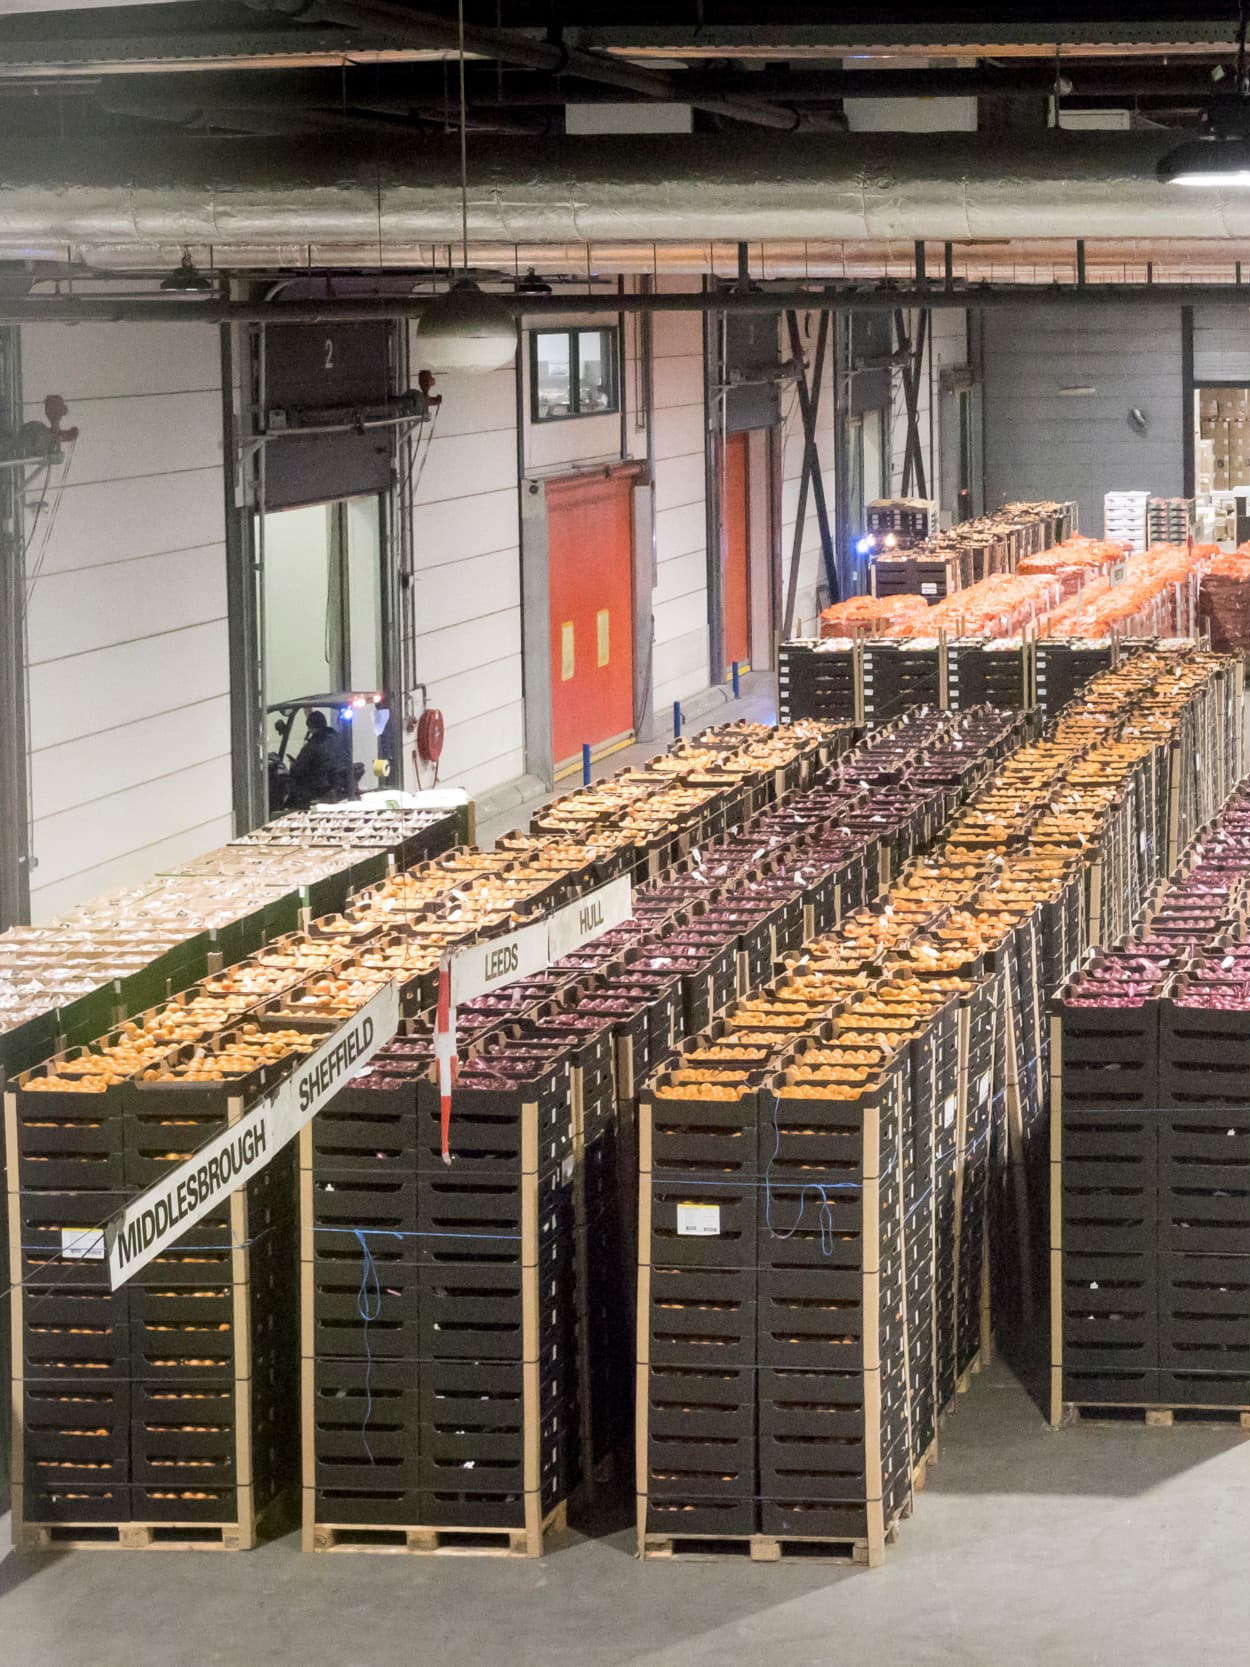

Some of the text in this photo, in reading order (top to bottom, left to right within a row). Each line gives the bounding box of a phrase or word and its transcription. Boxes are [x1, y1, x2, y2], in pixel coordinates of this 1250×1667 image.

[325, 338, 334, 369] 2
[579, 900, 604, 935] HULL
[484, 943, 518, 982] LEEDS
[299, 1016, 374, 1112] SHEFFIELD
[117, 1118, 266, 1270] MIDDLESBROUGH
